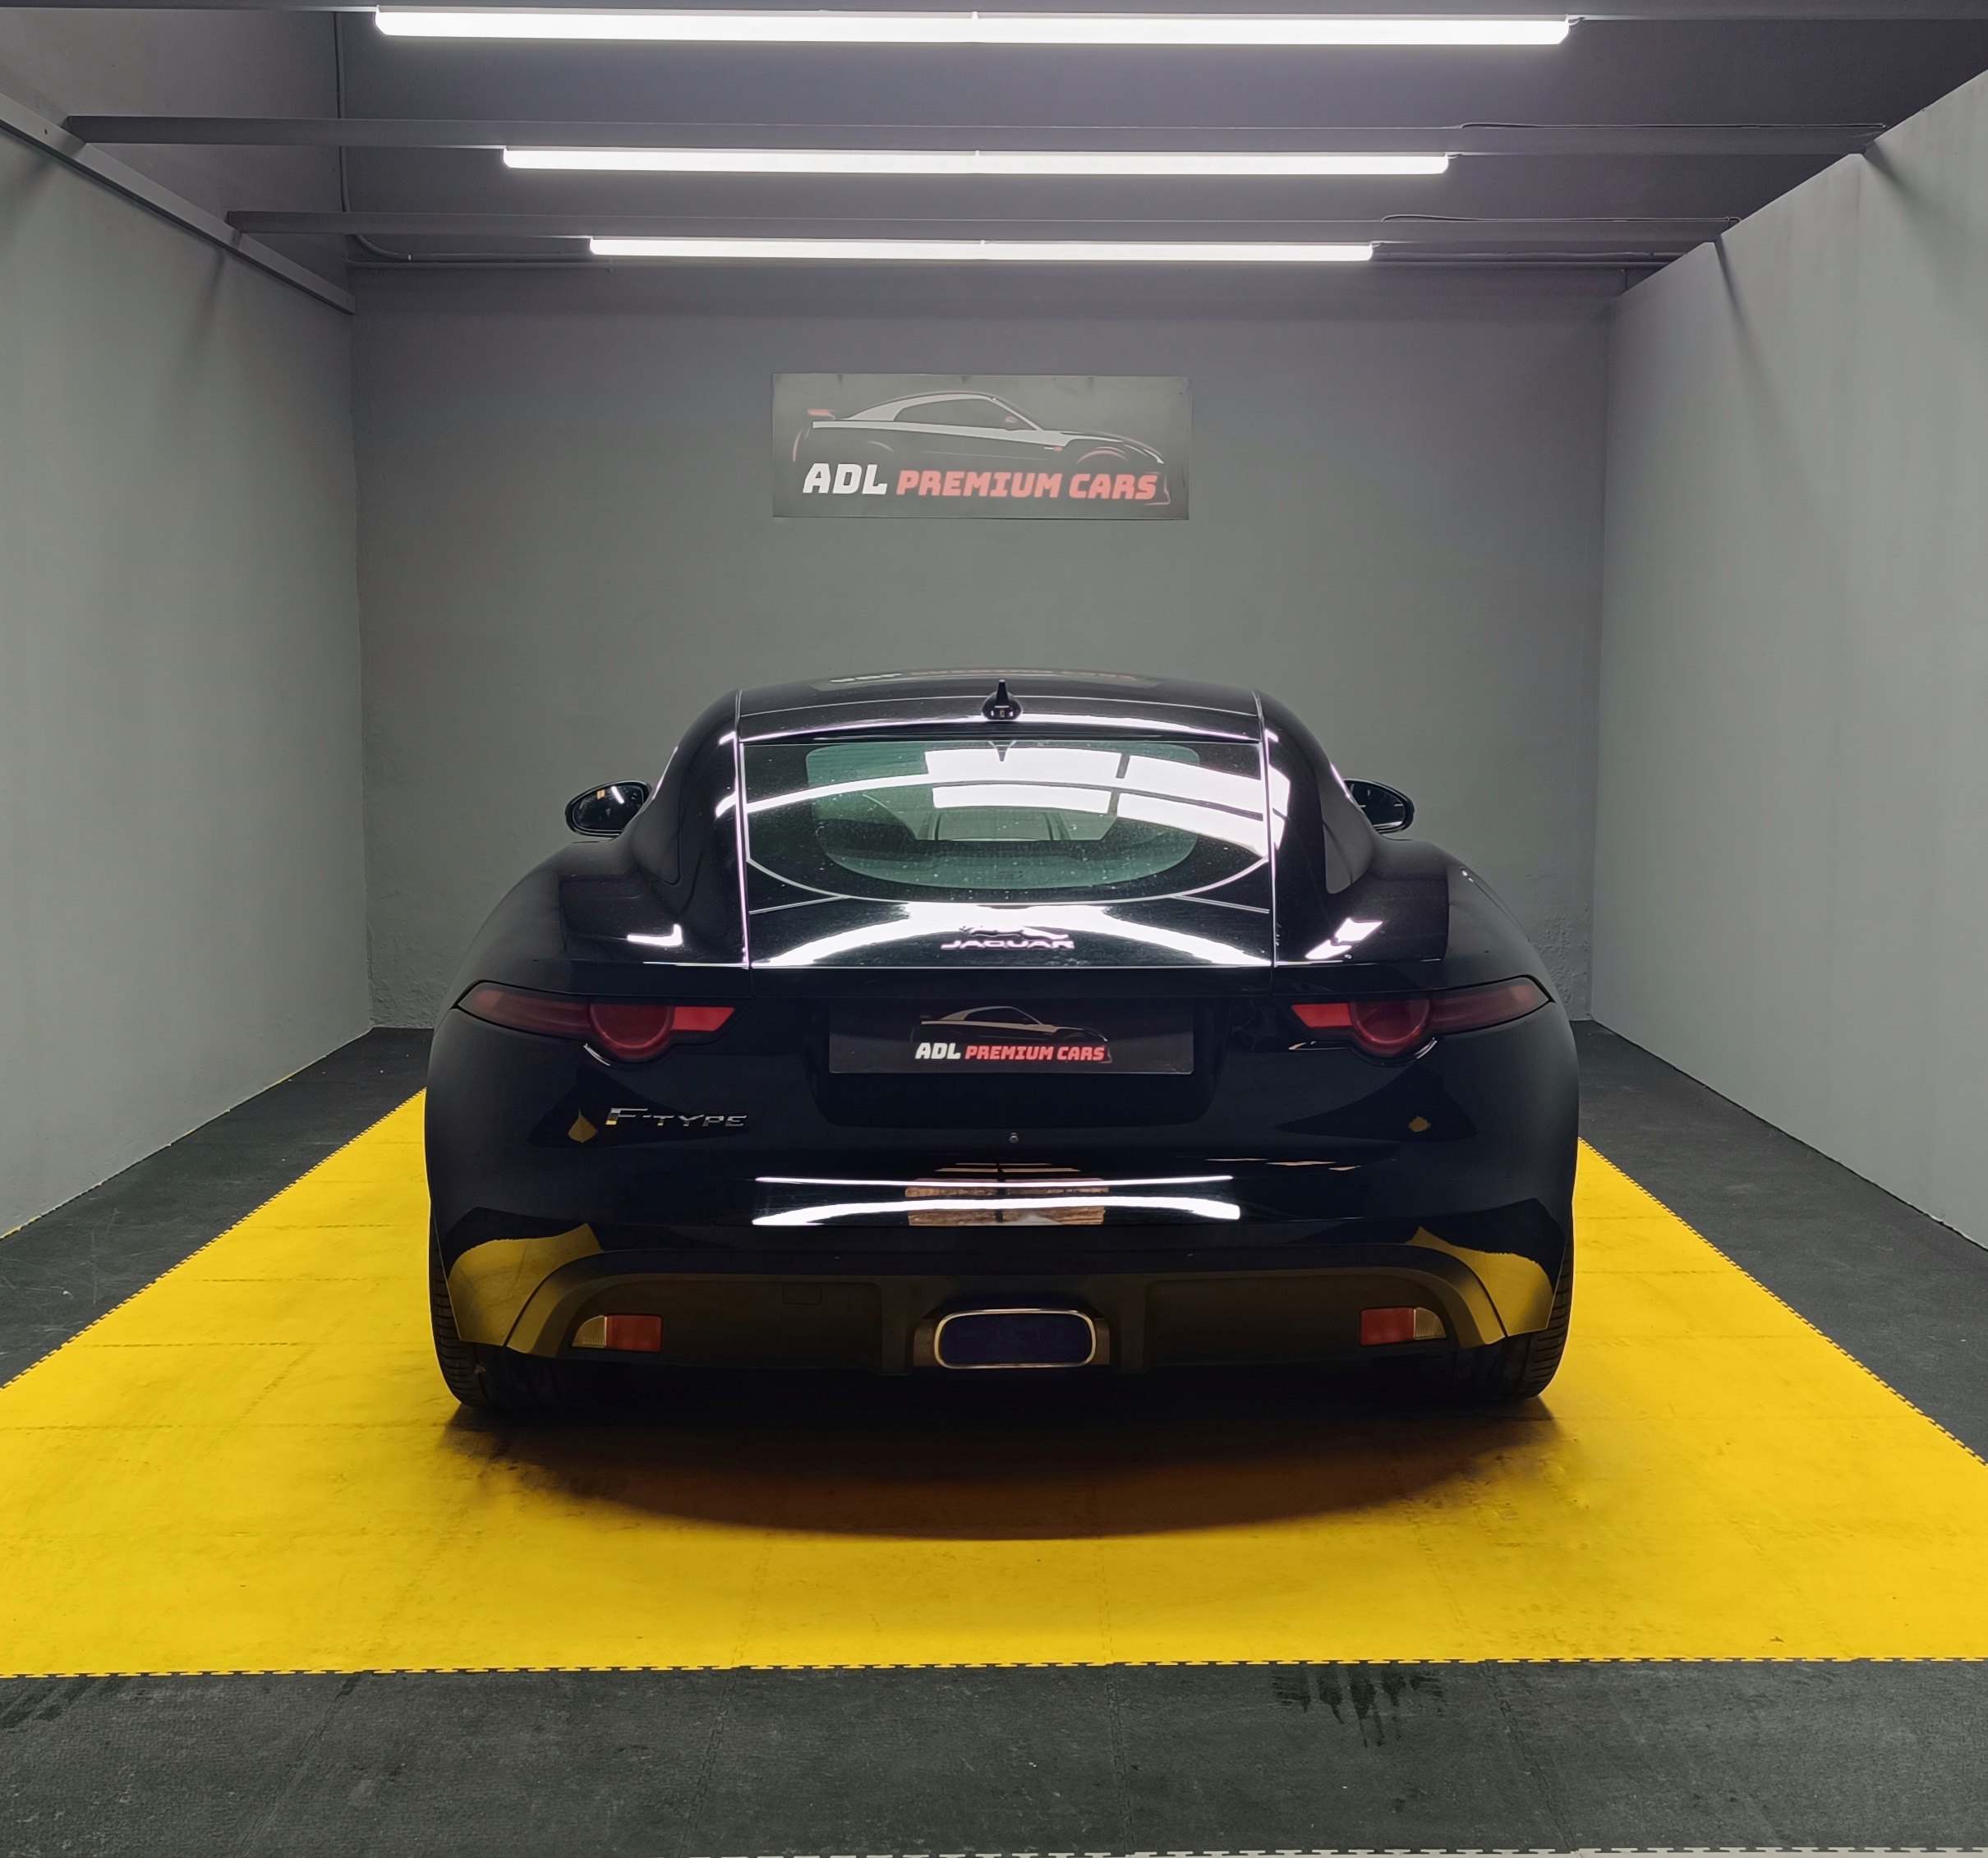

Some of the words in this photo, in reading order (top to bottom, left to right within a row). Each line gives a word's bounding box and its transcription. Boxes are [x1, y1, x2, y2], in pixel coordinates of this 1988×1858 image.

[803, 463, 887, 494] ADL
[896, 470, 1063, 498] PREMIUM
[1068, 473, 1157, 500] CARS
[915, 1042, 961, 1060] ADL
[965, 1045, 1054, 1060] PREMIUM
[1056, 1046, 1105, 1061] CARS
[605, 1107, 748, 1127] F-TYPE
